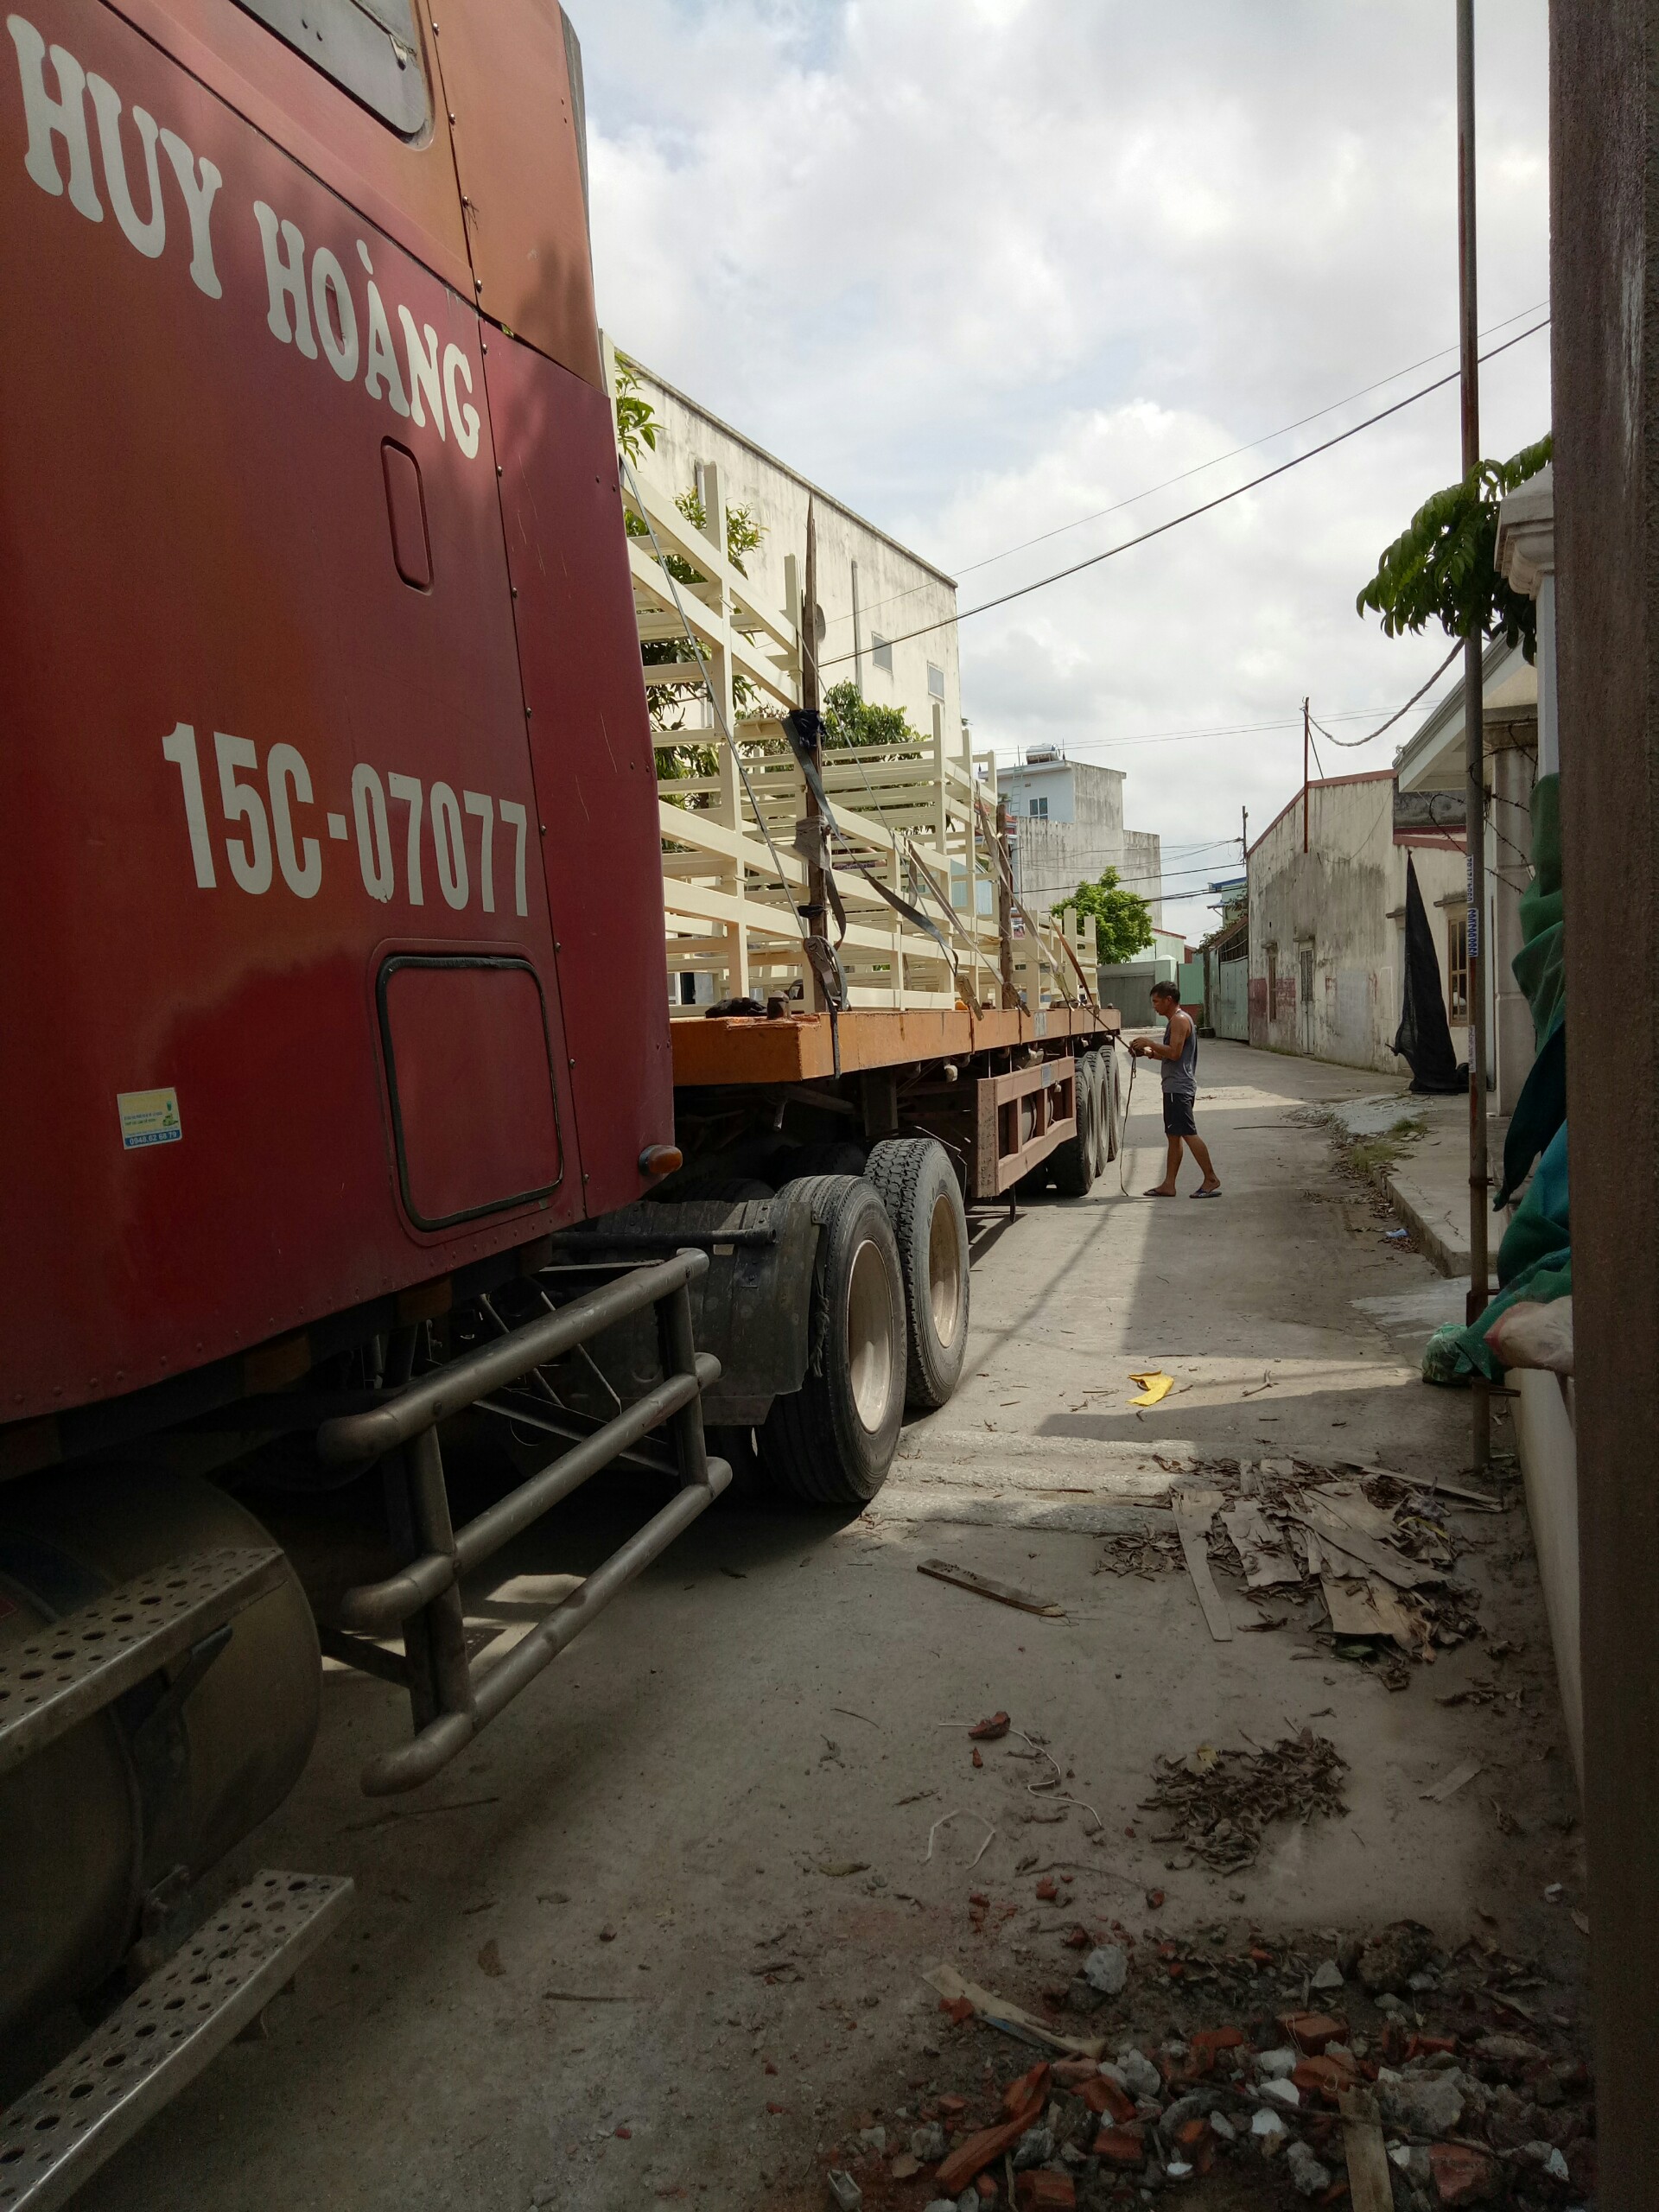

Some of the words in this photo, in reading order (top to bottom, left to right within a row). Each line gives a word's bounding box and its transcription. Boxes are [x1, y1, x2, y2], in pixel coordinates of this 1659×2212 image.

[7, 14, 223, 300] HUY
[253, 200, 481, 461] HOÀNG
[162, 721, 530, 918] 15C-07077
